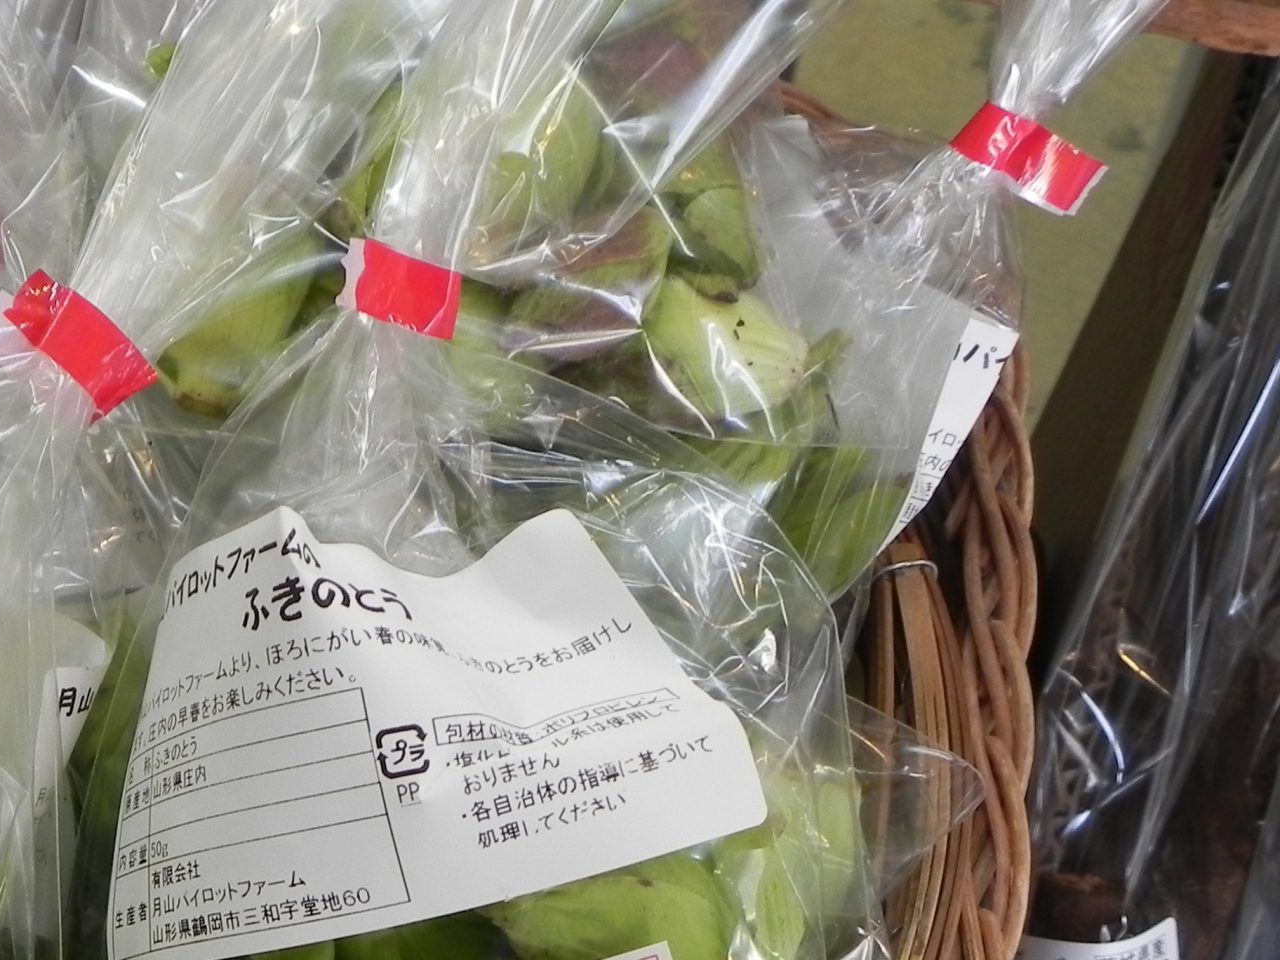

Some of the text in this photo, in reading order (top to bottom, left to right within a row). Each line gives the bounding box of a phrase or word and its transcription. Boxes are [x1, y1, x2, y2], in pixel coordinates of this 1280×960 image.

[161, 528, 321, 620] パイロットファームの
[241, 576, 413, 631] ふきのとう
[58, 686, 95, 717] 月山
[152, 764, 207, 801] 山形県庄内
[463, 752, 561, 796] おりません
[396, 782, 421, 806] PP
[151, 860, 202, 890] 有限会社
[151, 870, 307, 919] 月山パイロットファーム
[114, 903, 149, 930] 生産者
